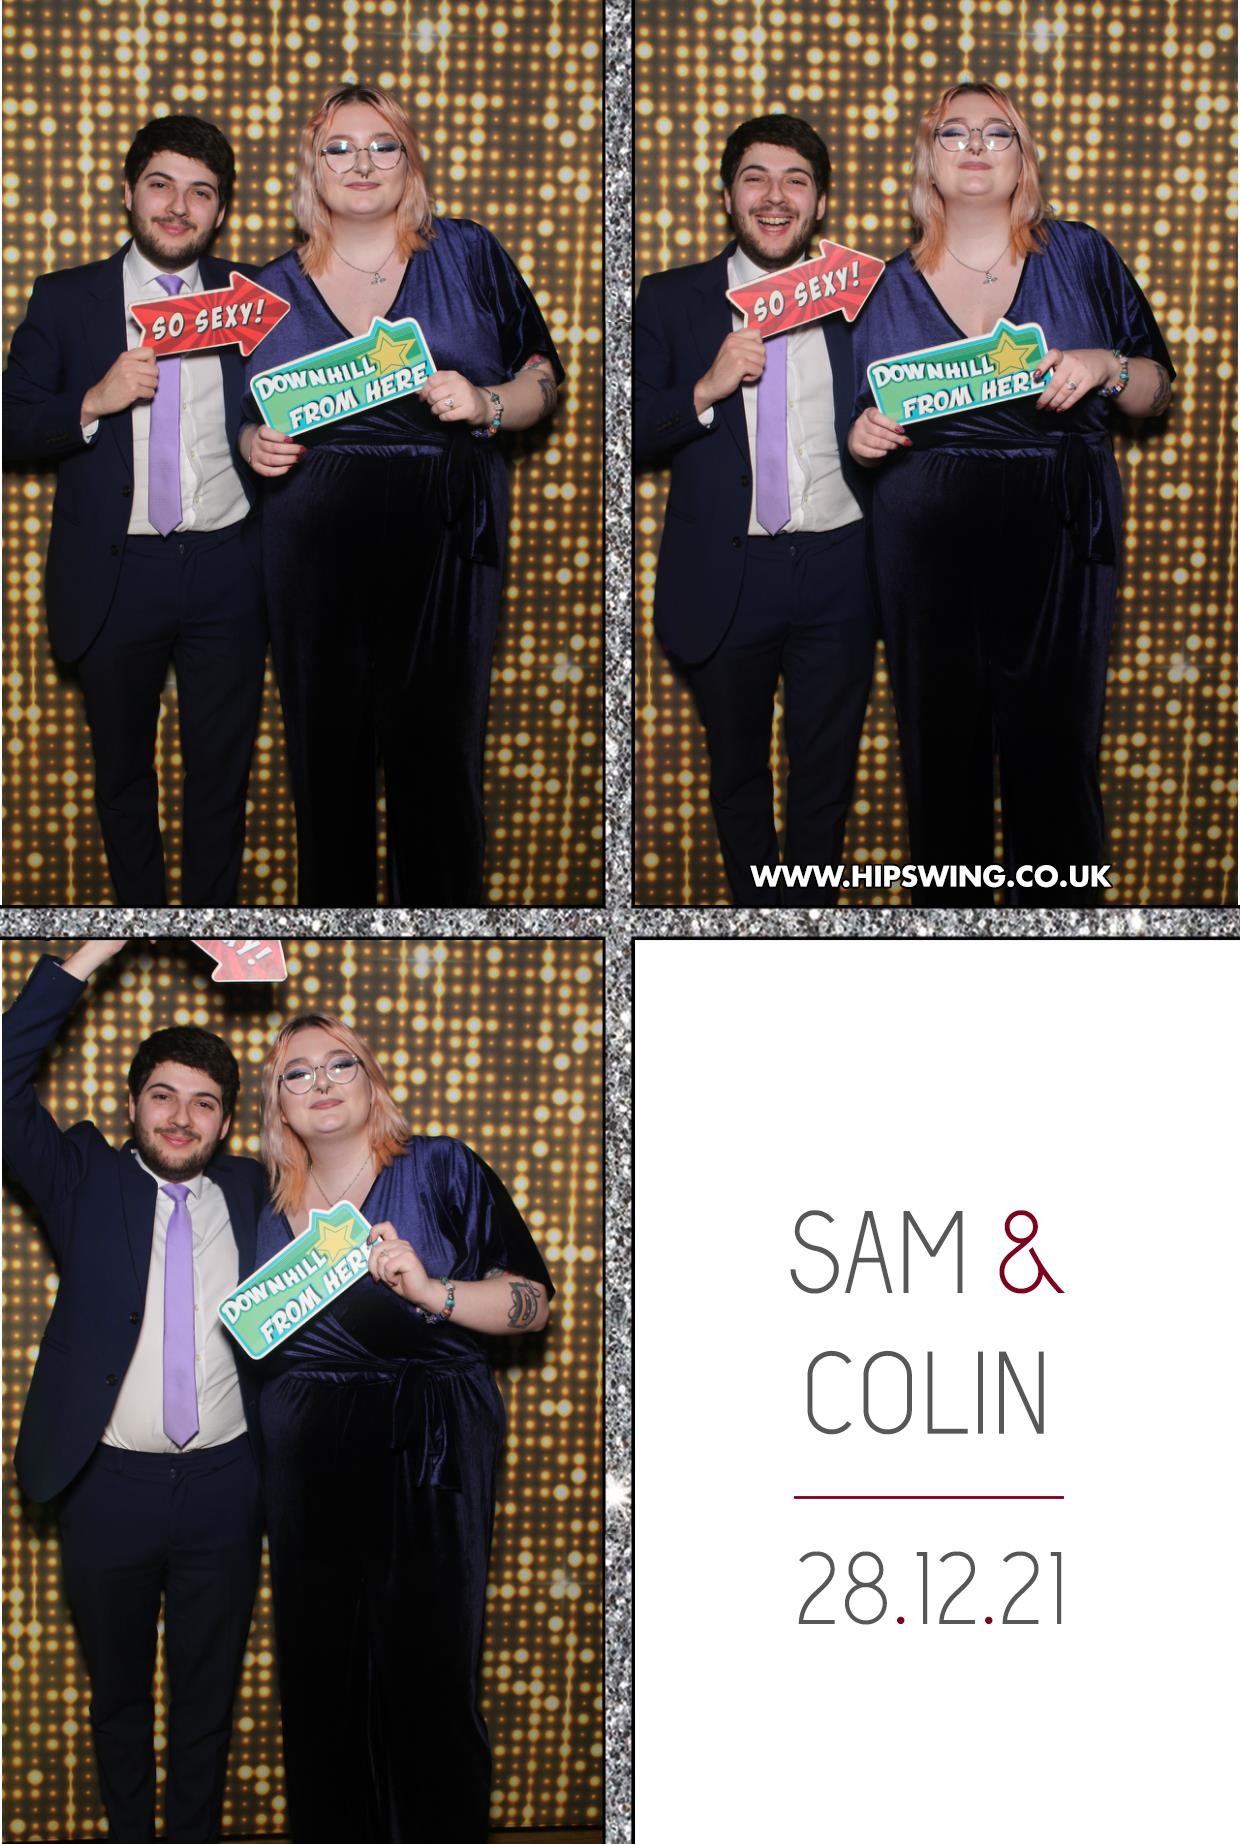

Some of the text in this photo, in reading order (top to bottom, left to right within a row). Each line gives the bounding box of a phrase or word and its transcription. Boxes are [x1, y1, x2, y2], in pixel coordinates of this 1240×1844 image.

[754, 261, 860, 324] SO SEXY!
[152, 299, 265, 340] SO SEXY!
[255, 354, 377, 400] DOWNHILL
[289, 361, 428, 429] FROM HERE
[872, 354, 995, 388] DOWNHILL
[903, 385, 974, 419] FROM
[221, 1250, 327, 1325] DOWNHILL
[260, 1286, 323, 1344] FROM
